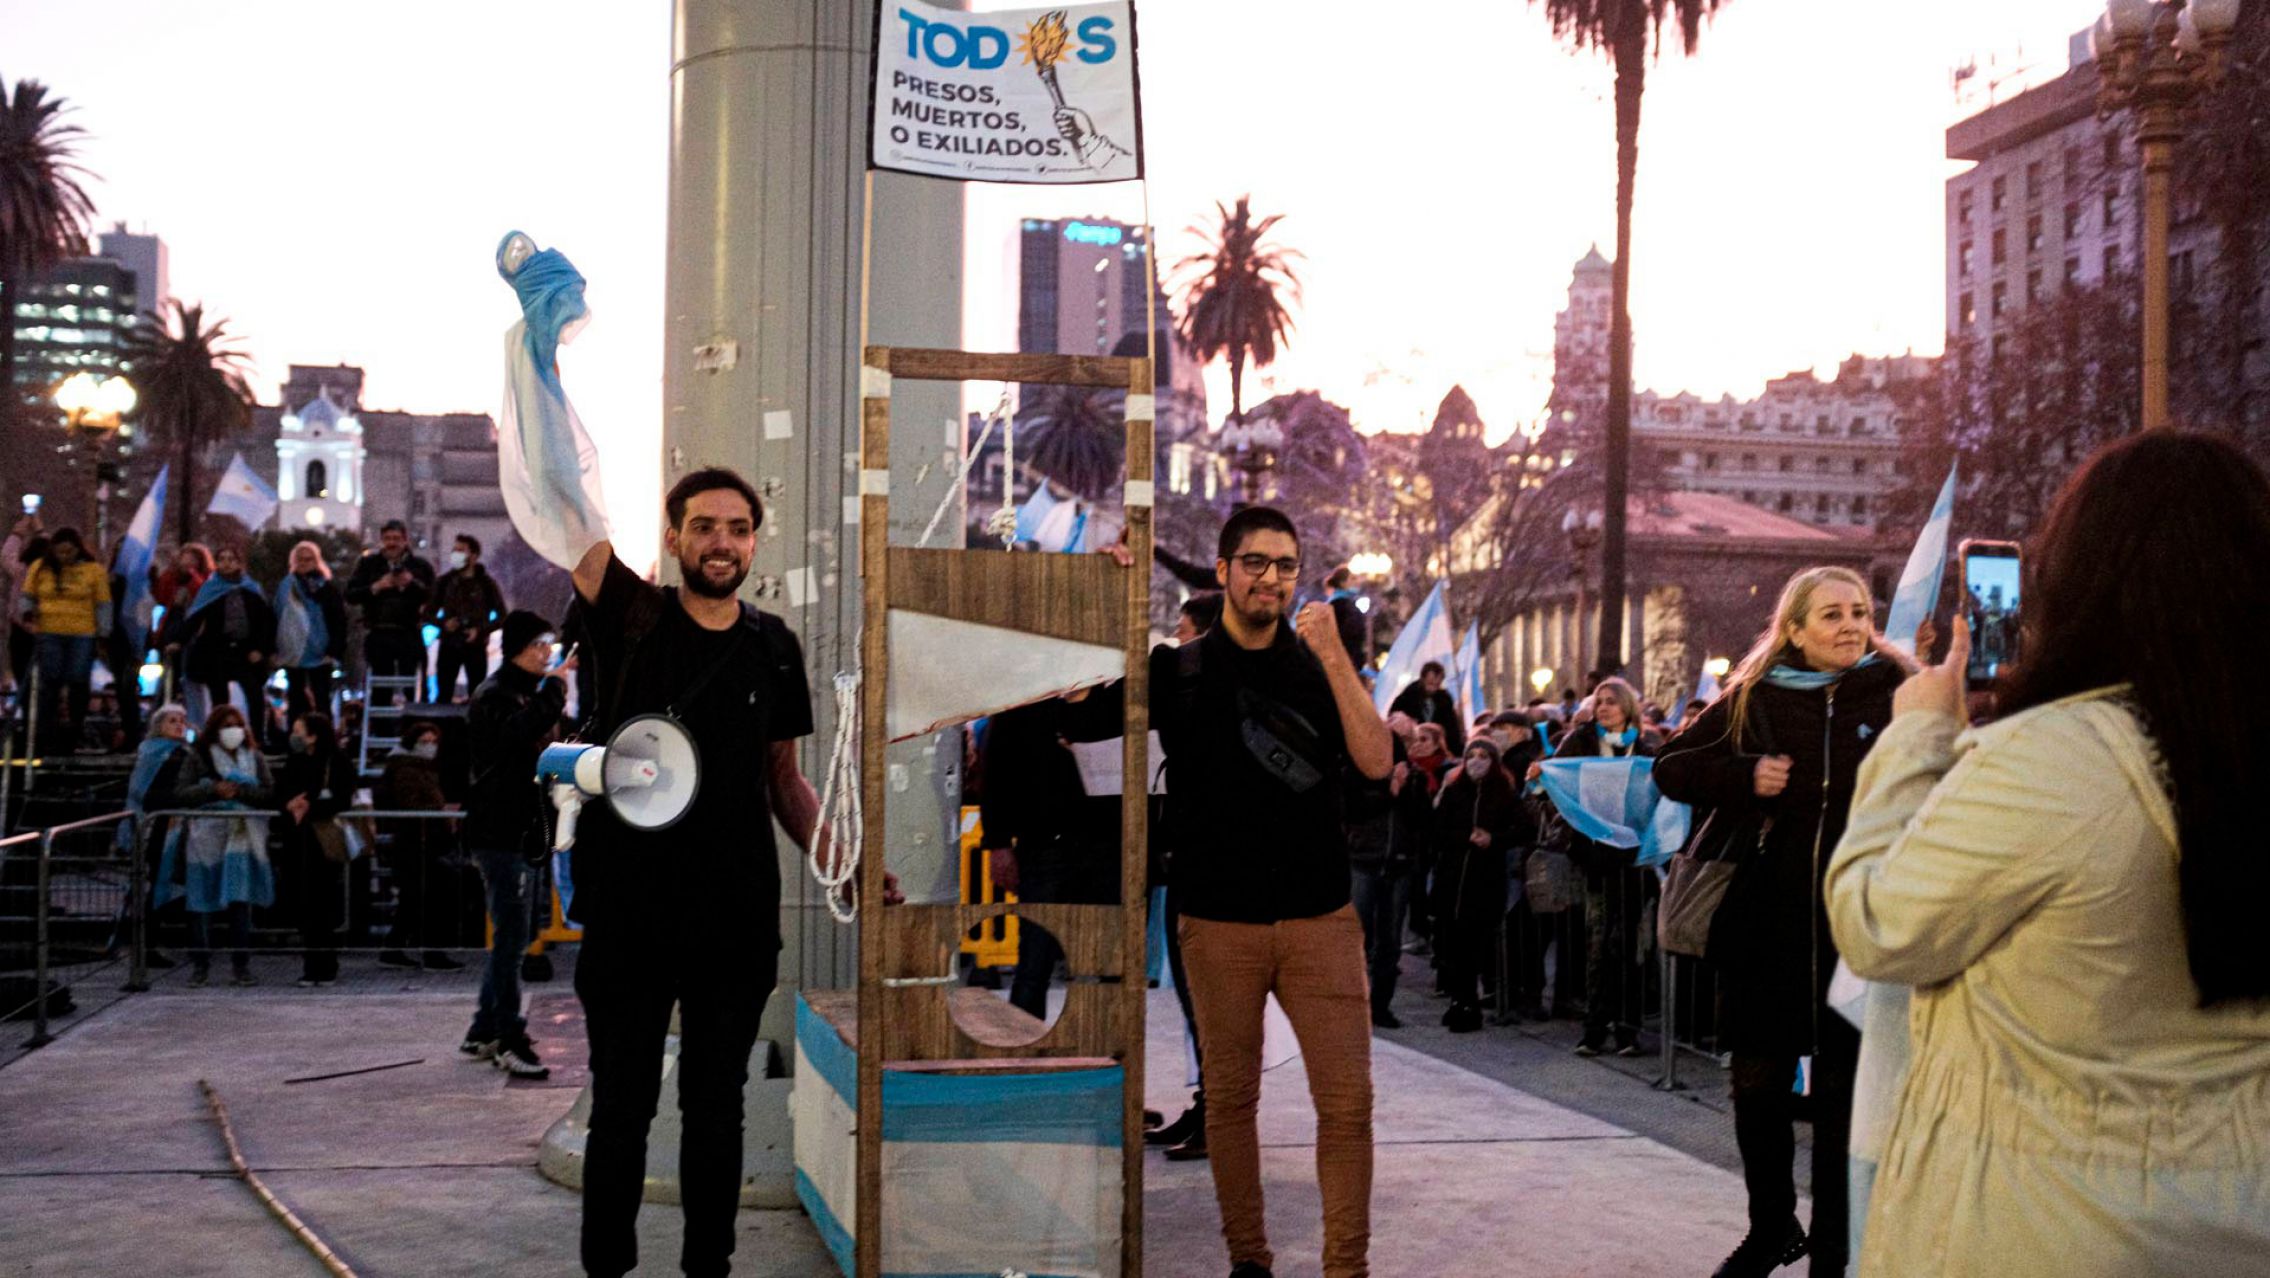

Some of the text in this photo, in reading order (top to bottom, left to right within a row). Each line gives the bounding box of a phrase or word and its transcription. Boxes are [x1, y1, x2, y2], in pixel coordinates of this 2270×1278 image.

[898, 7, 1117, 70] TODS
[893, 71, 1001, 106] PRESOS,
[892, 98, 1026, 132] MUERTOS,
[890, 126, 1069, 157] O EXILIADOS.
